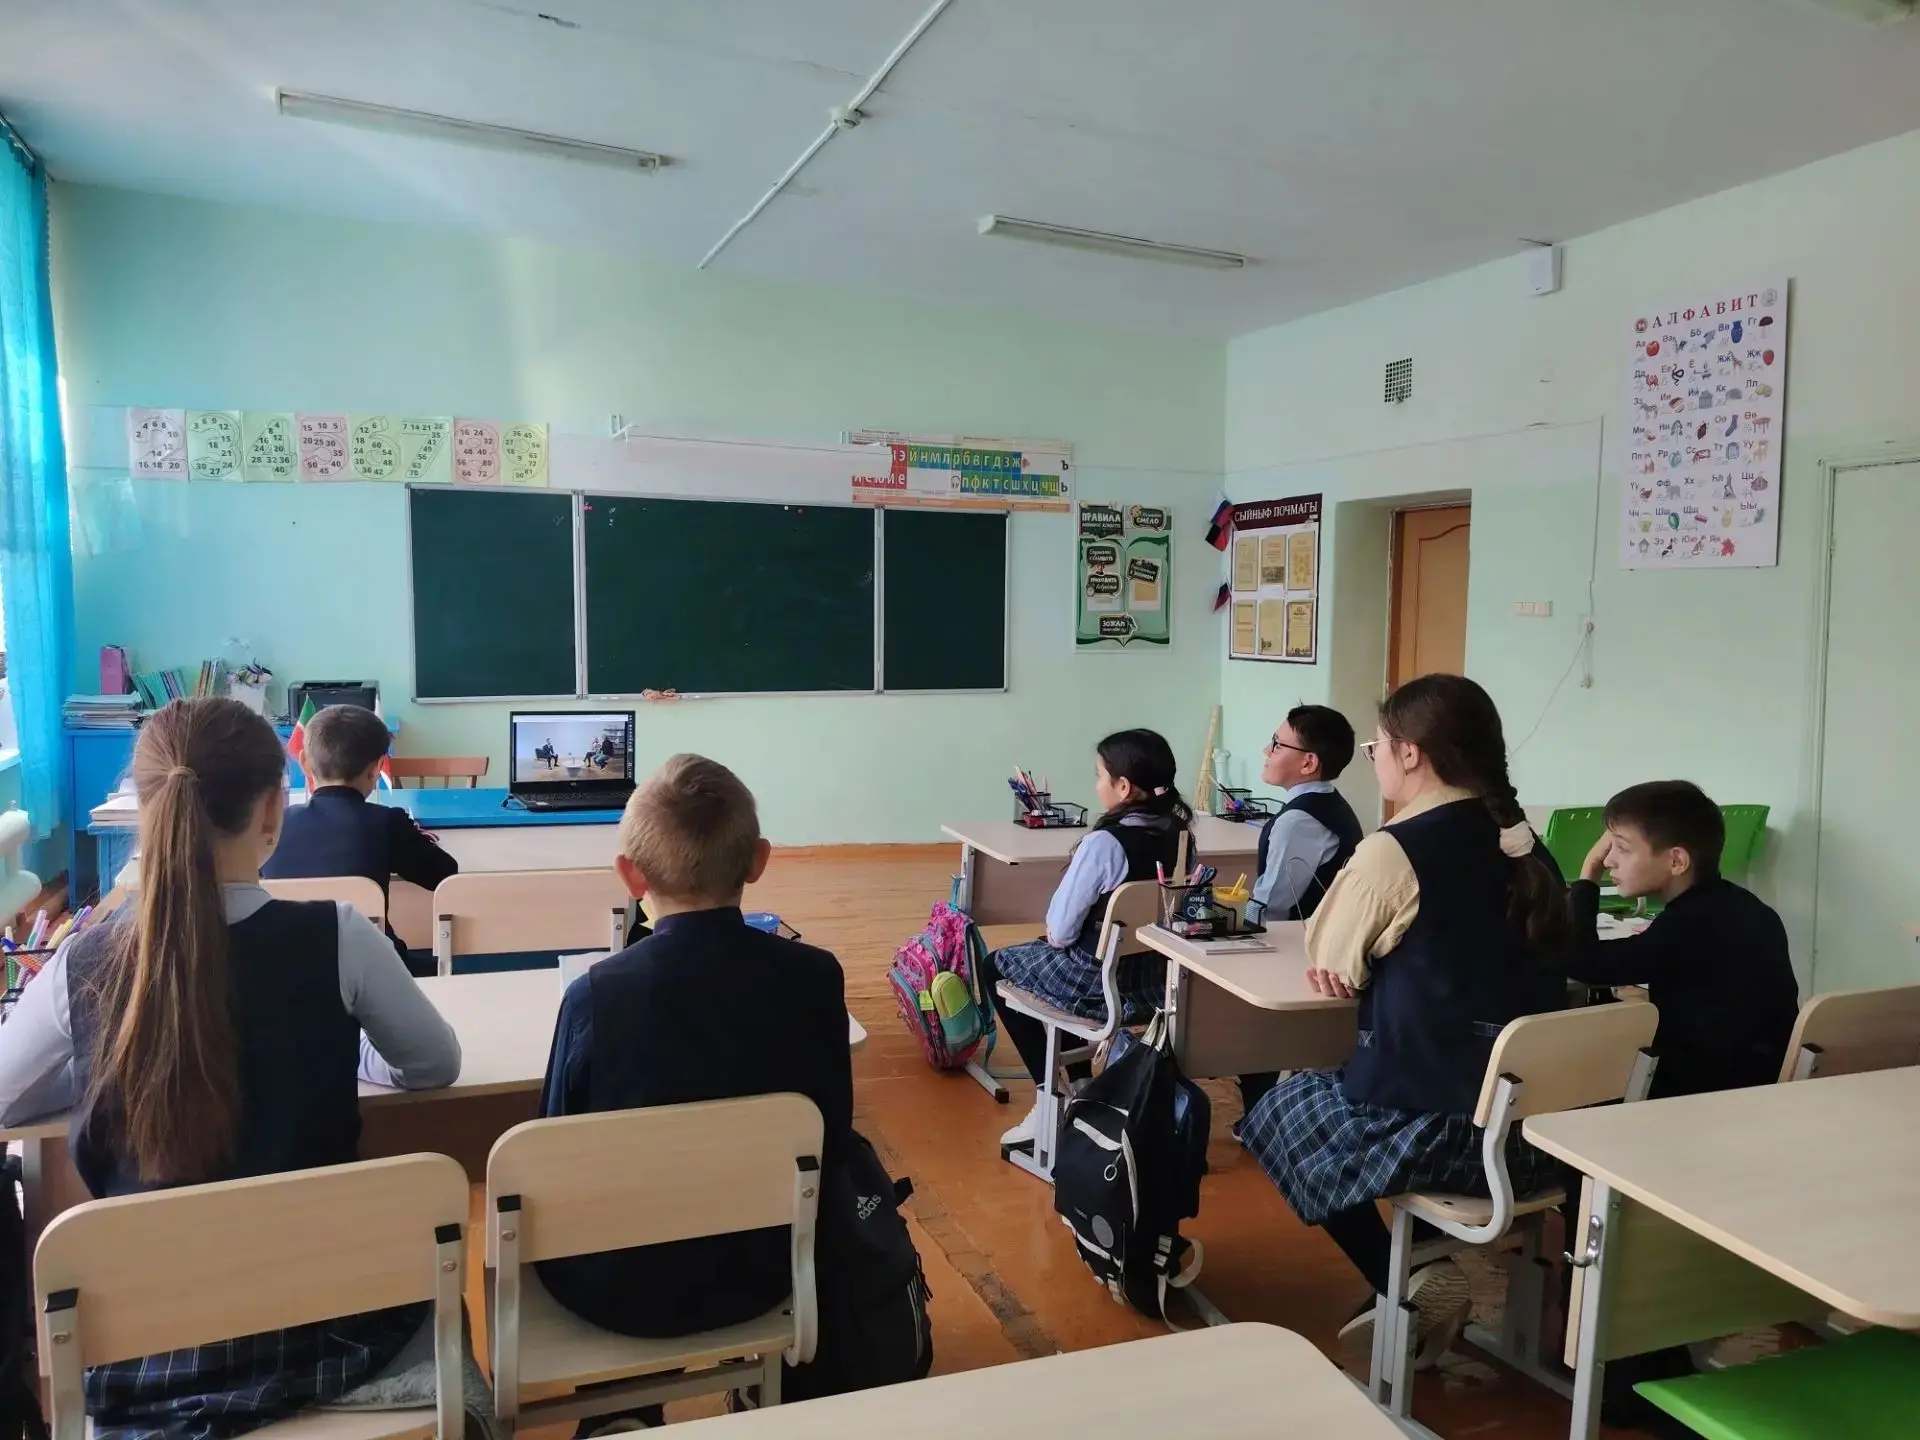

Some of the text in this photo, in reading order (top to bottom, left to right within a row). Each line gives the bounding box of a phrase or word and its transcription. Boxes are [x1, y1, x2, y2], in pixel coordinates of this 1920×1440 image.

[1652, 294, 1758, 328] АЛФАВИТ
[1747, 317, 1758, 326] Гг
[1718, 323, 1730, 332] Вв
[1717, 355, 1731, 364] Жж
[1745, 379, 1758, 388] Лл
[1716, 384, 1727, 392] Кк
[1714, 415, 1727, 423] Оо
[303, 424, 313, 432] 15
[1632, 426, 1645, 434] Мм
[221, 435, 231, 443] 15
[208, 441, 219, 449] 18
[1743, 440, 1754, 449] Уу
[221, 449, 232, 457] 21
[1658, 449, 1669, 458] Рр
[1685, 446, 1697, 454] Сс
[251, 456, 262, 464] 28
[1631, 452, 1643, 461] Пп
[138, 461, 149, 469] 16
[151, 461, 163, 469] 18
[1741, 472, 1754, 480] Цц
[1684, 477, 1695, 485] Хх
[1234, 501, 1318, 522] СЫЙНЫФ ПОЧМАГЫ
[1081, 512, 1121, 523] ПРАВИЛА
